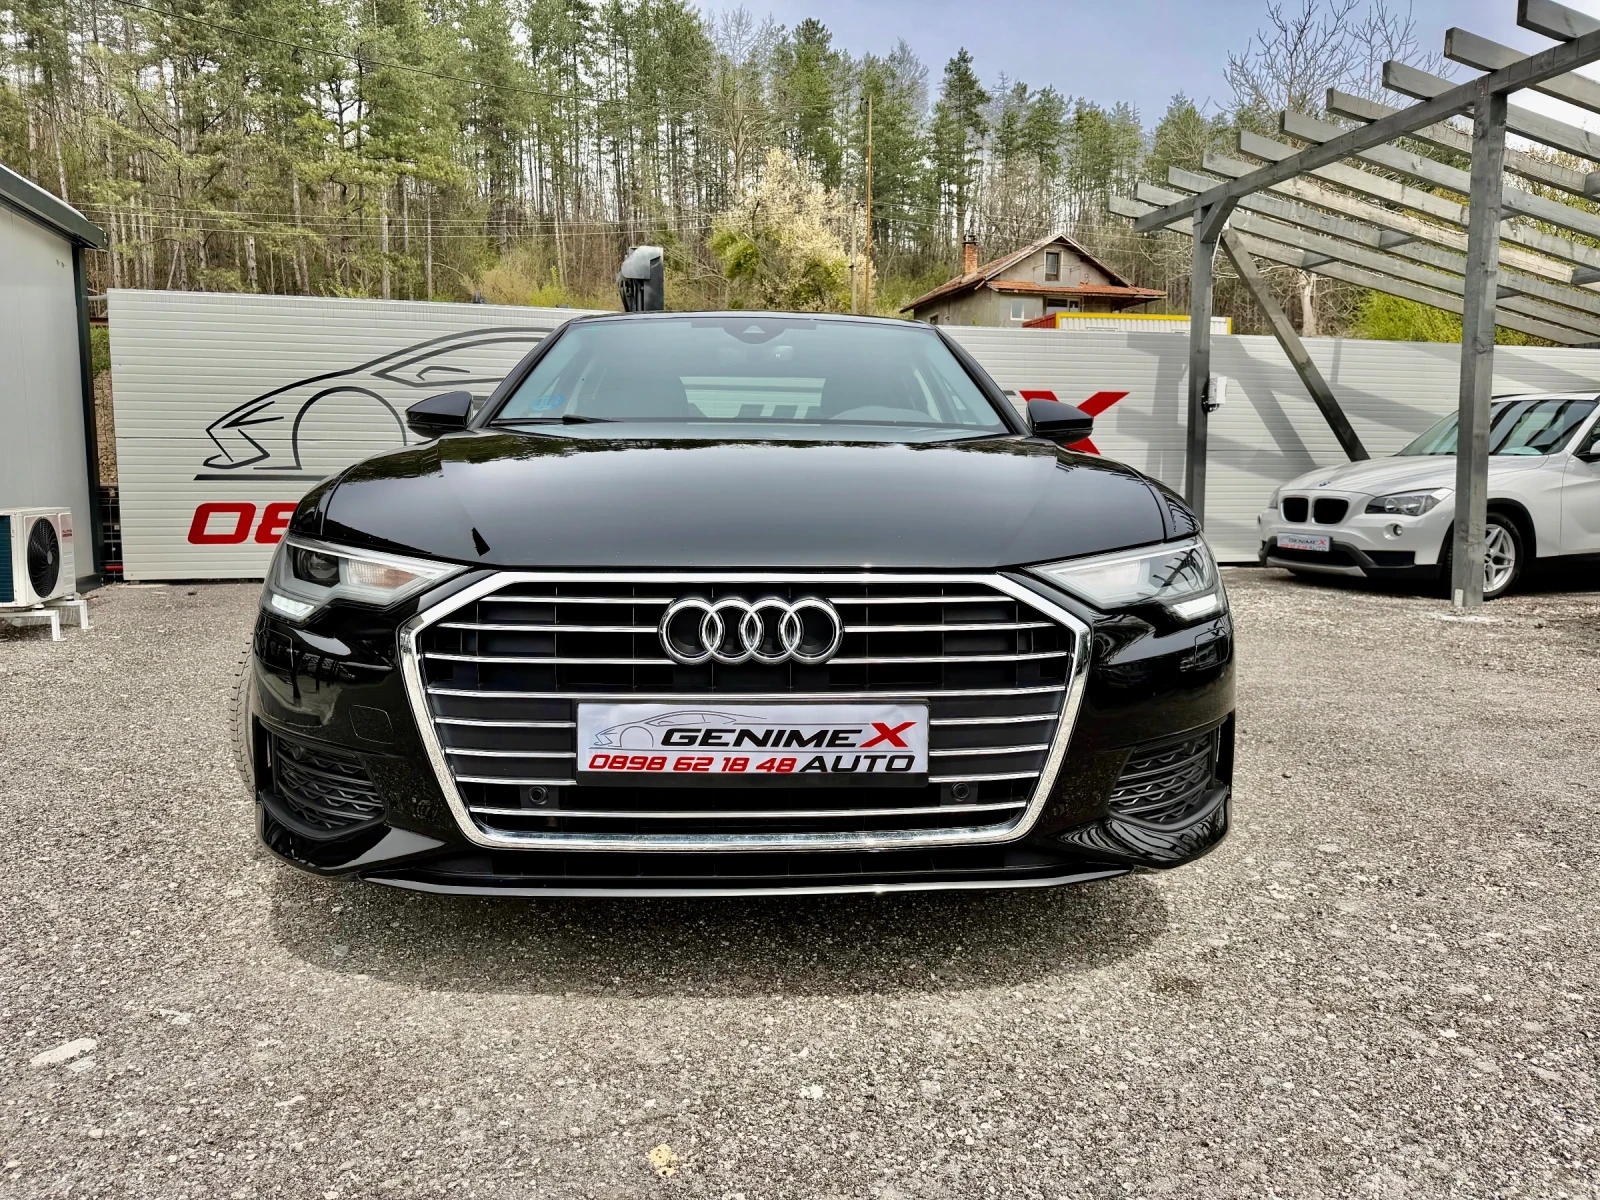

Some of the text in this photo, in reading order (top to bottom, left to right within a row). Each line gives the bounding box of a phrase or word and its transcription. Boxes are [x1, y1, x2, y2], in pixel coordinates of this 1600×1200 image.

[660, 721, 917, 748] GENIMEX
[588, 754, 916, 773] 0898 62 18 48 AUTO
